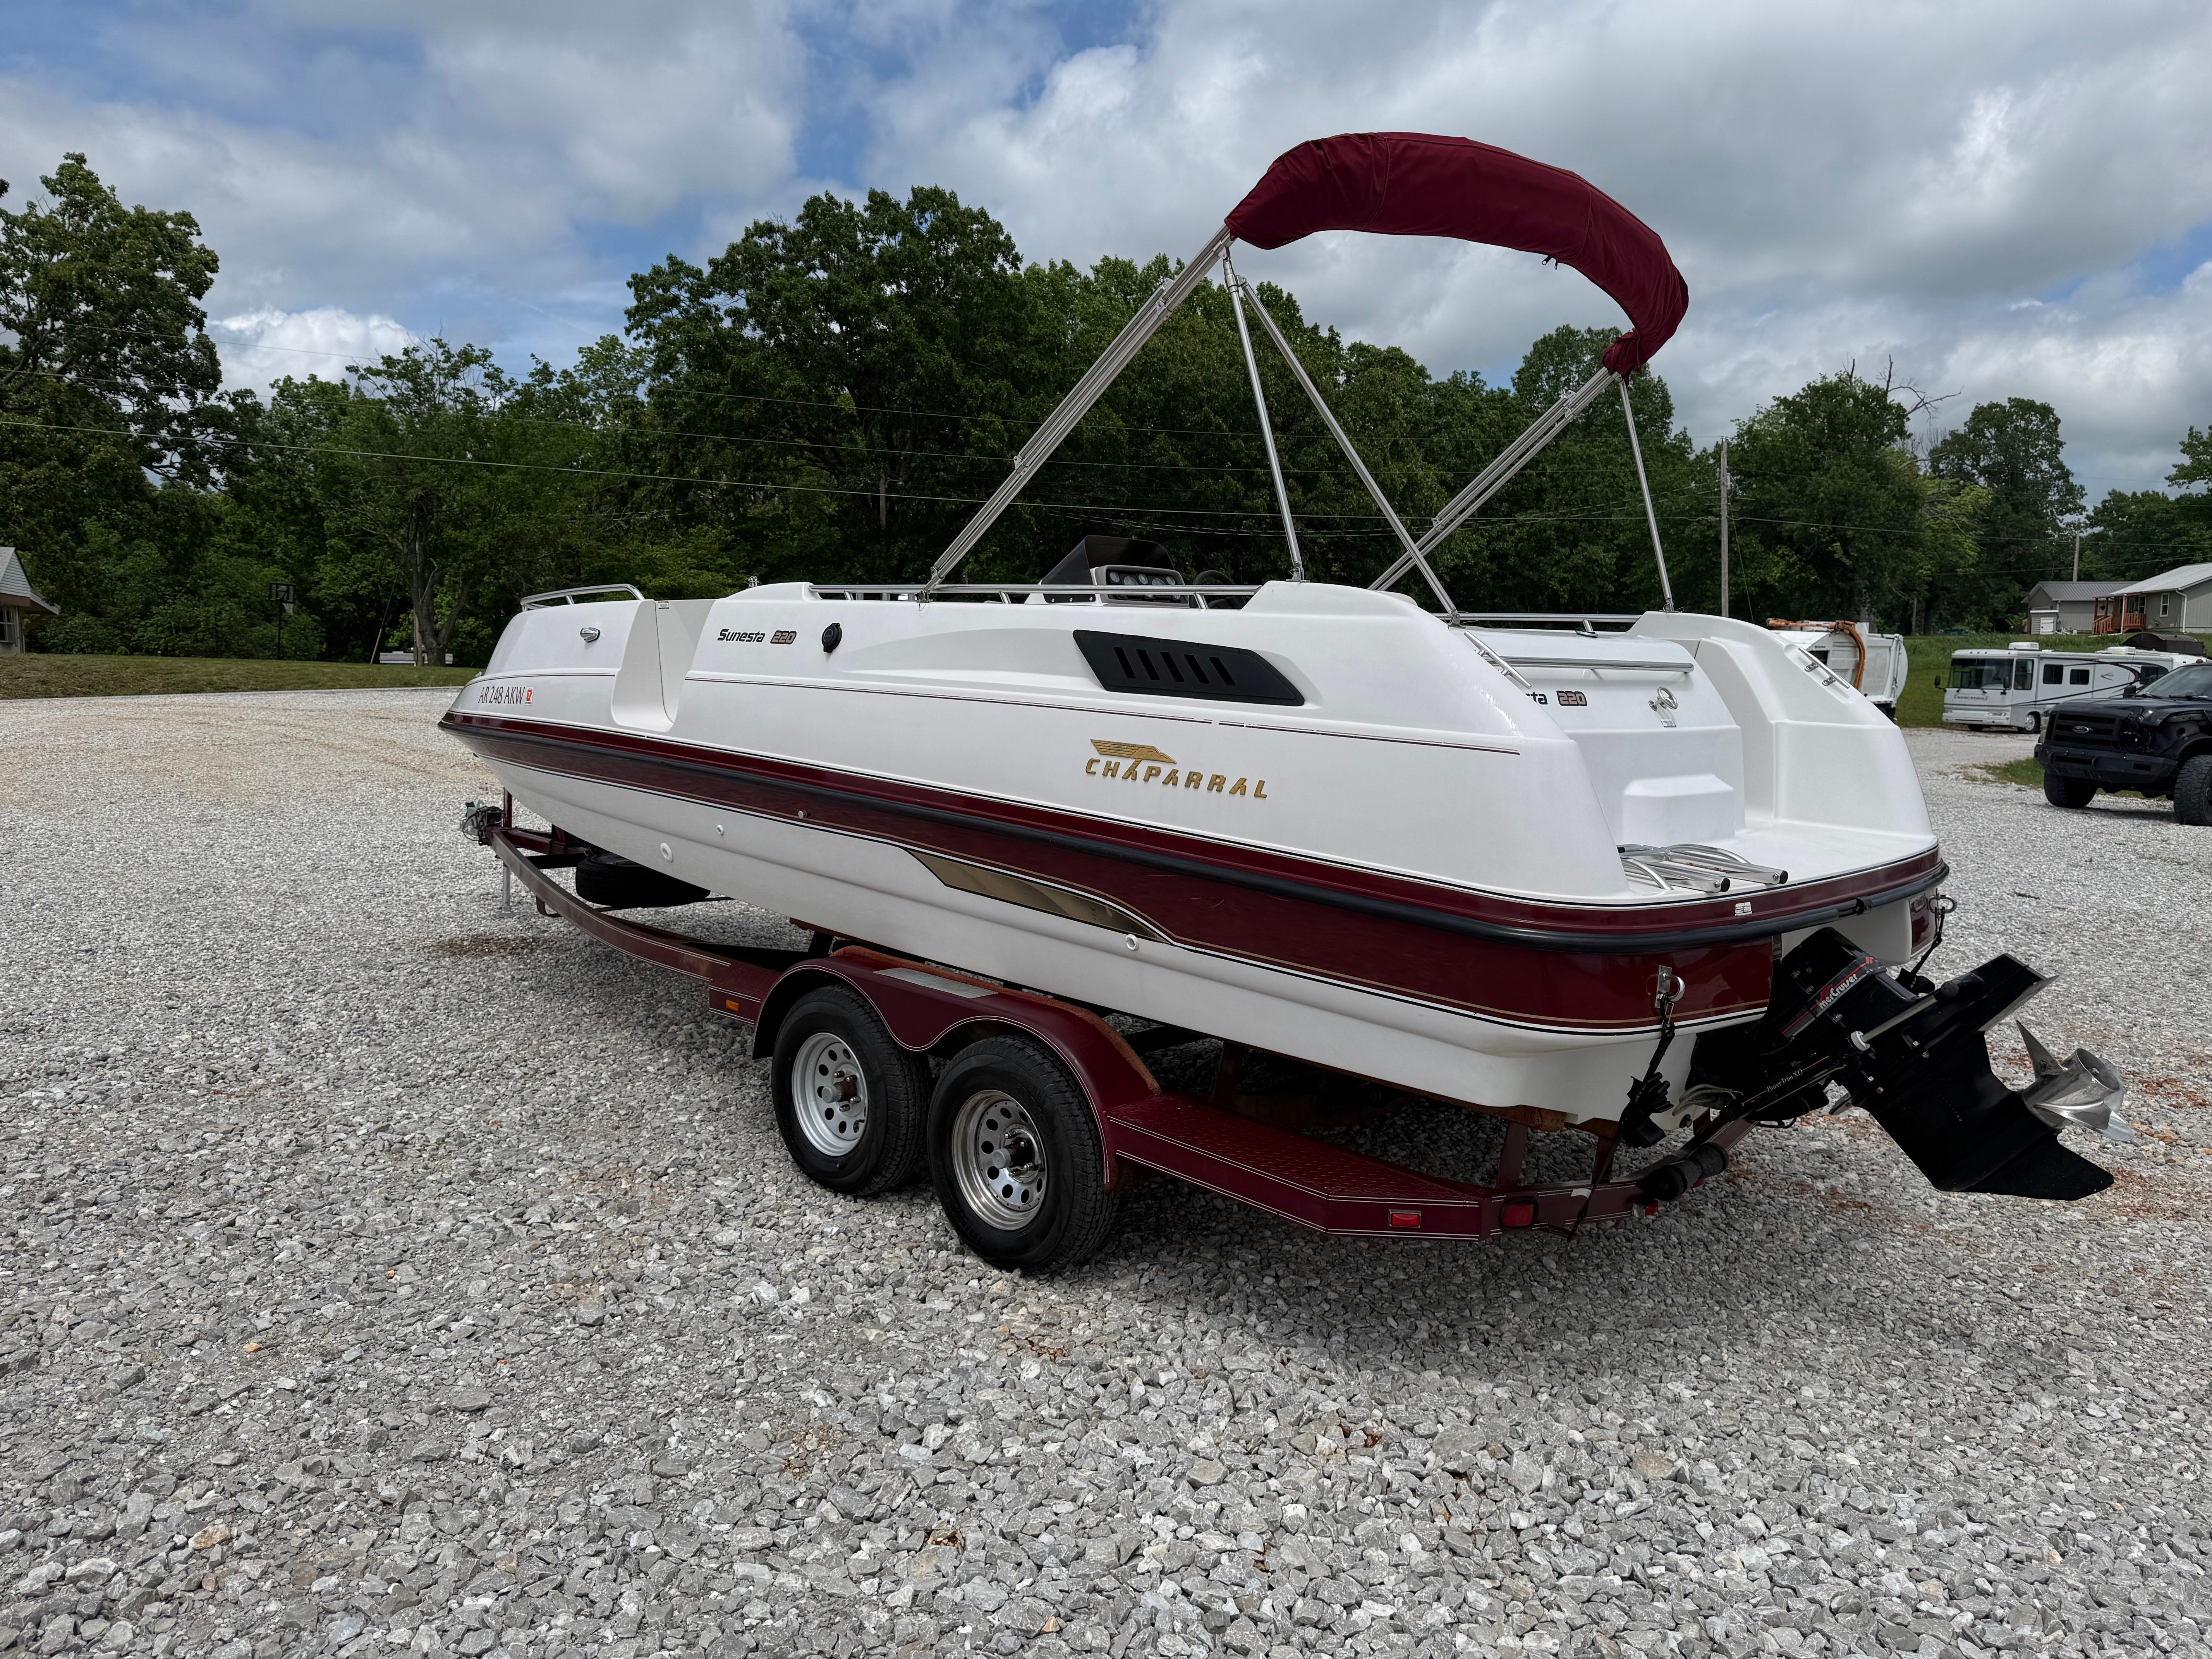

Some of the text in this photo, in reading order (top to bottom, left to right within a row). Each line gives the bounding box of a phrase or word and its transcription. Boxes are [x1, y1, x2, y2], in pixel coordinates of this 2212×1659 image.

[717, 629, 797, 645] Sunesta 220
[478, 686, 525, 705] AR 248 AKW
[1556, 690, 1587, 706] 220
[1085, 757, 1267, 799] CHAPARRAL
[1767, 1069, 1803, 1092] Power Trim XD
